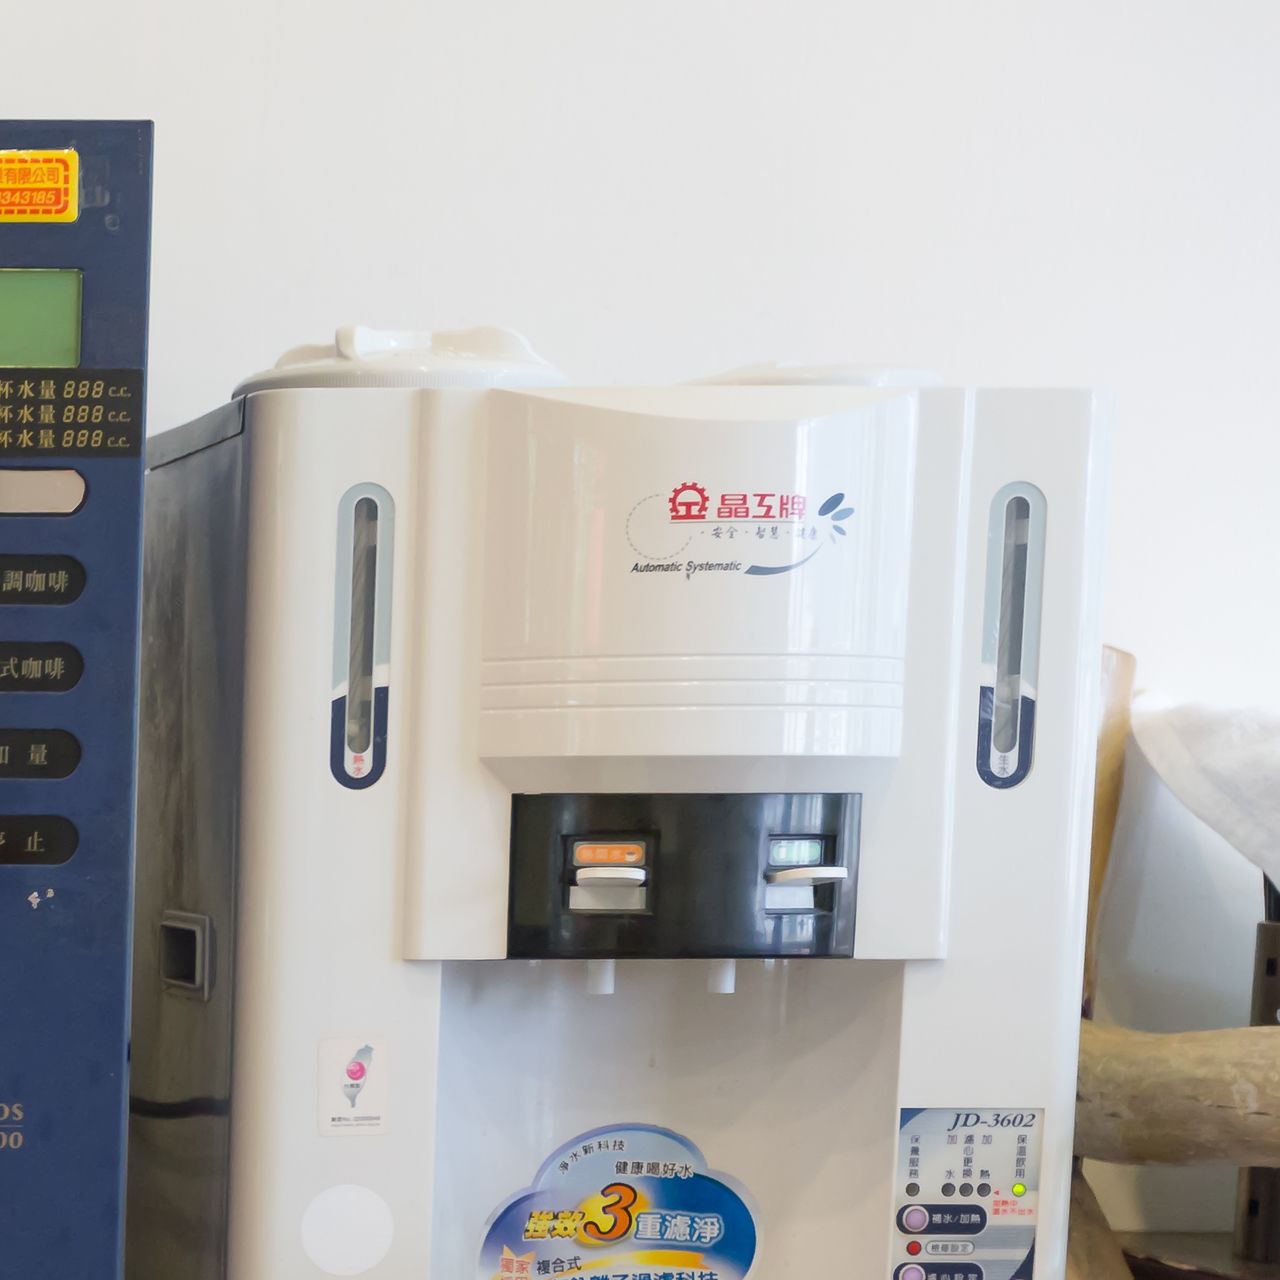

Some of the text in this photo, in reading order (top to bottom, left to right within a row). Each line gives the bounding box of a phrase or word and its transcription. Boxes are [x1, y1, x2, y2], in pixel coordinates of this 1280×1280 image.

[717, 494, 807, 520] 晶工牌
[631, 560, 742, 576] Automatic Systematic
[947, 1112, 1036, 1132] JD-3602
[615, 1160, 694, 1179] 健康喝好水
